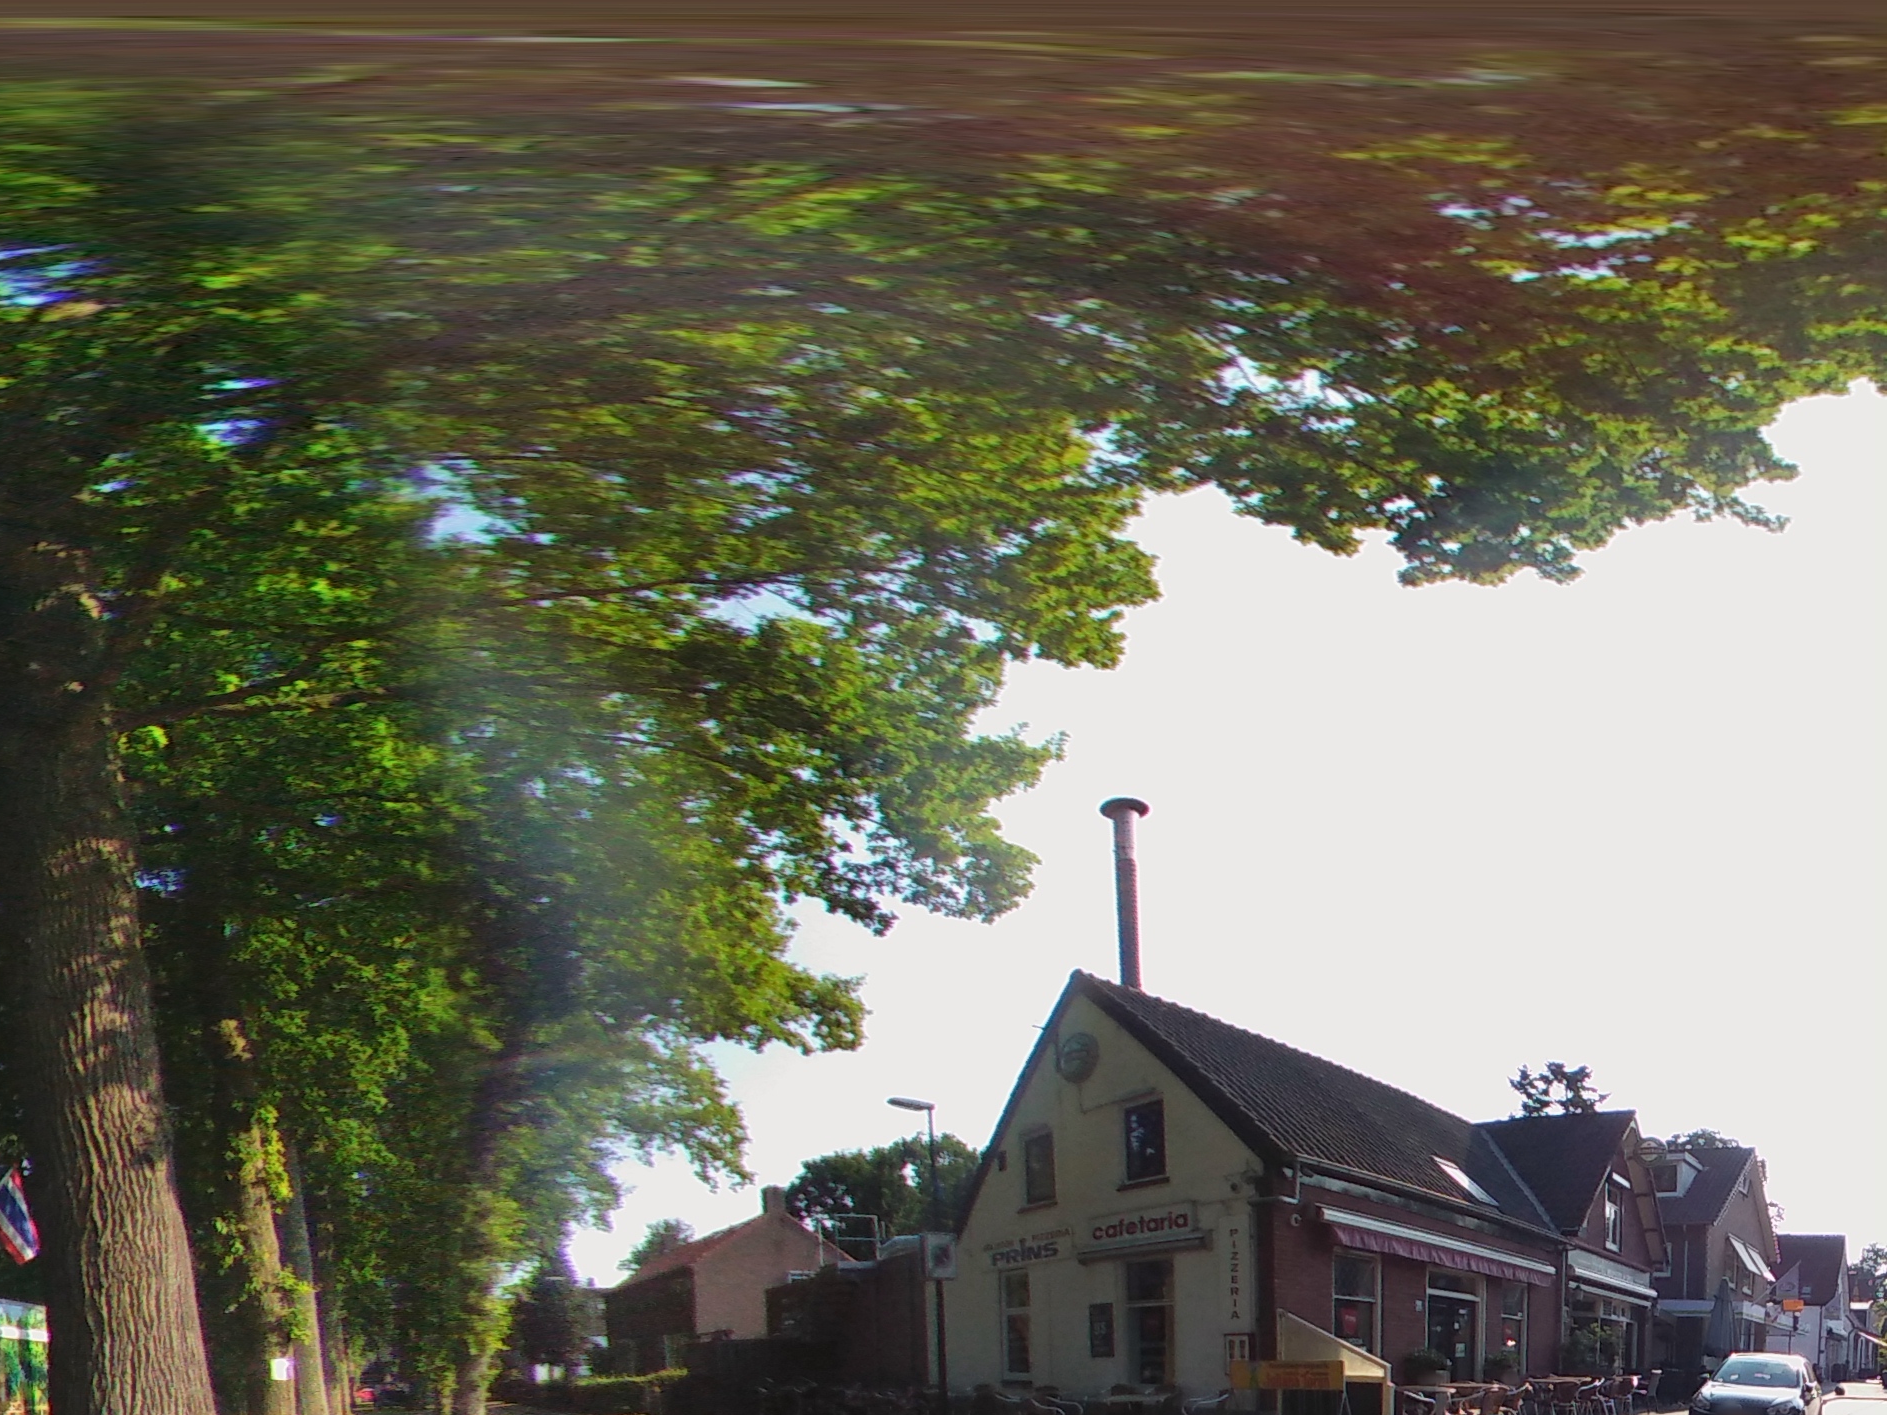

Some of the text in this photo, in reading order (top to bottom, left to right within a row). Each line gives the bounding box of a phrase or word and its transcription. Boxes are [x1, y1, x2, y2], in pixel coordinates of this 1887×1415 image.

[1092, 1211, 1189, 1240] cafetaria
[991, 1237, 1059, 1267] PRINS
[1229, 1228, 1241, 1320] PIZZERIA
